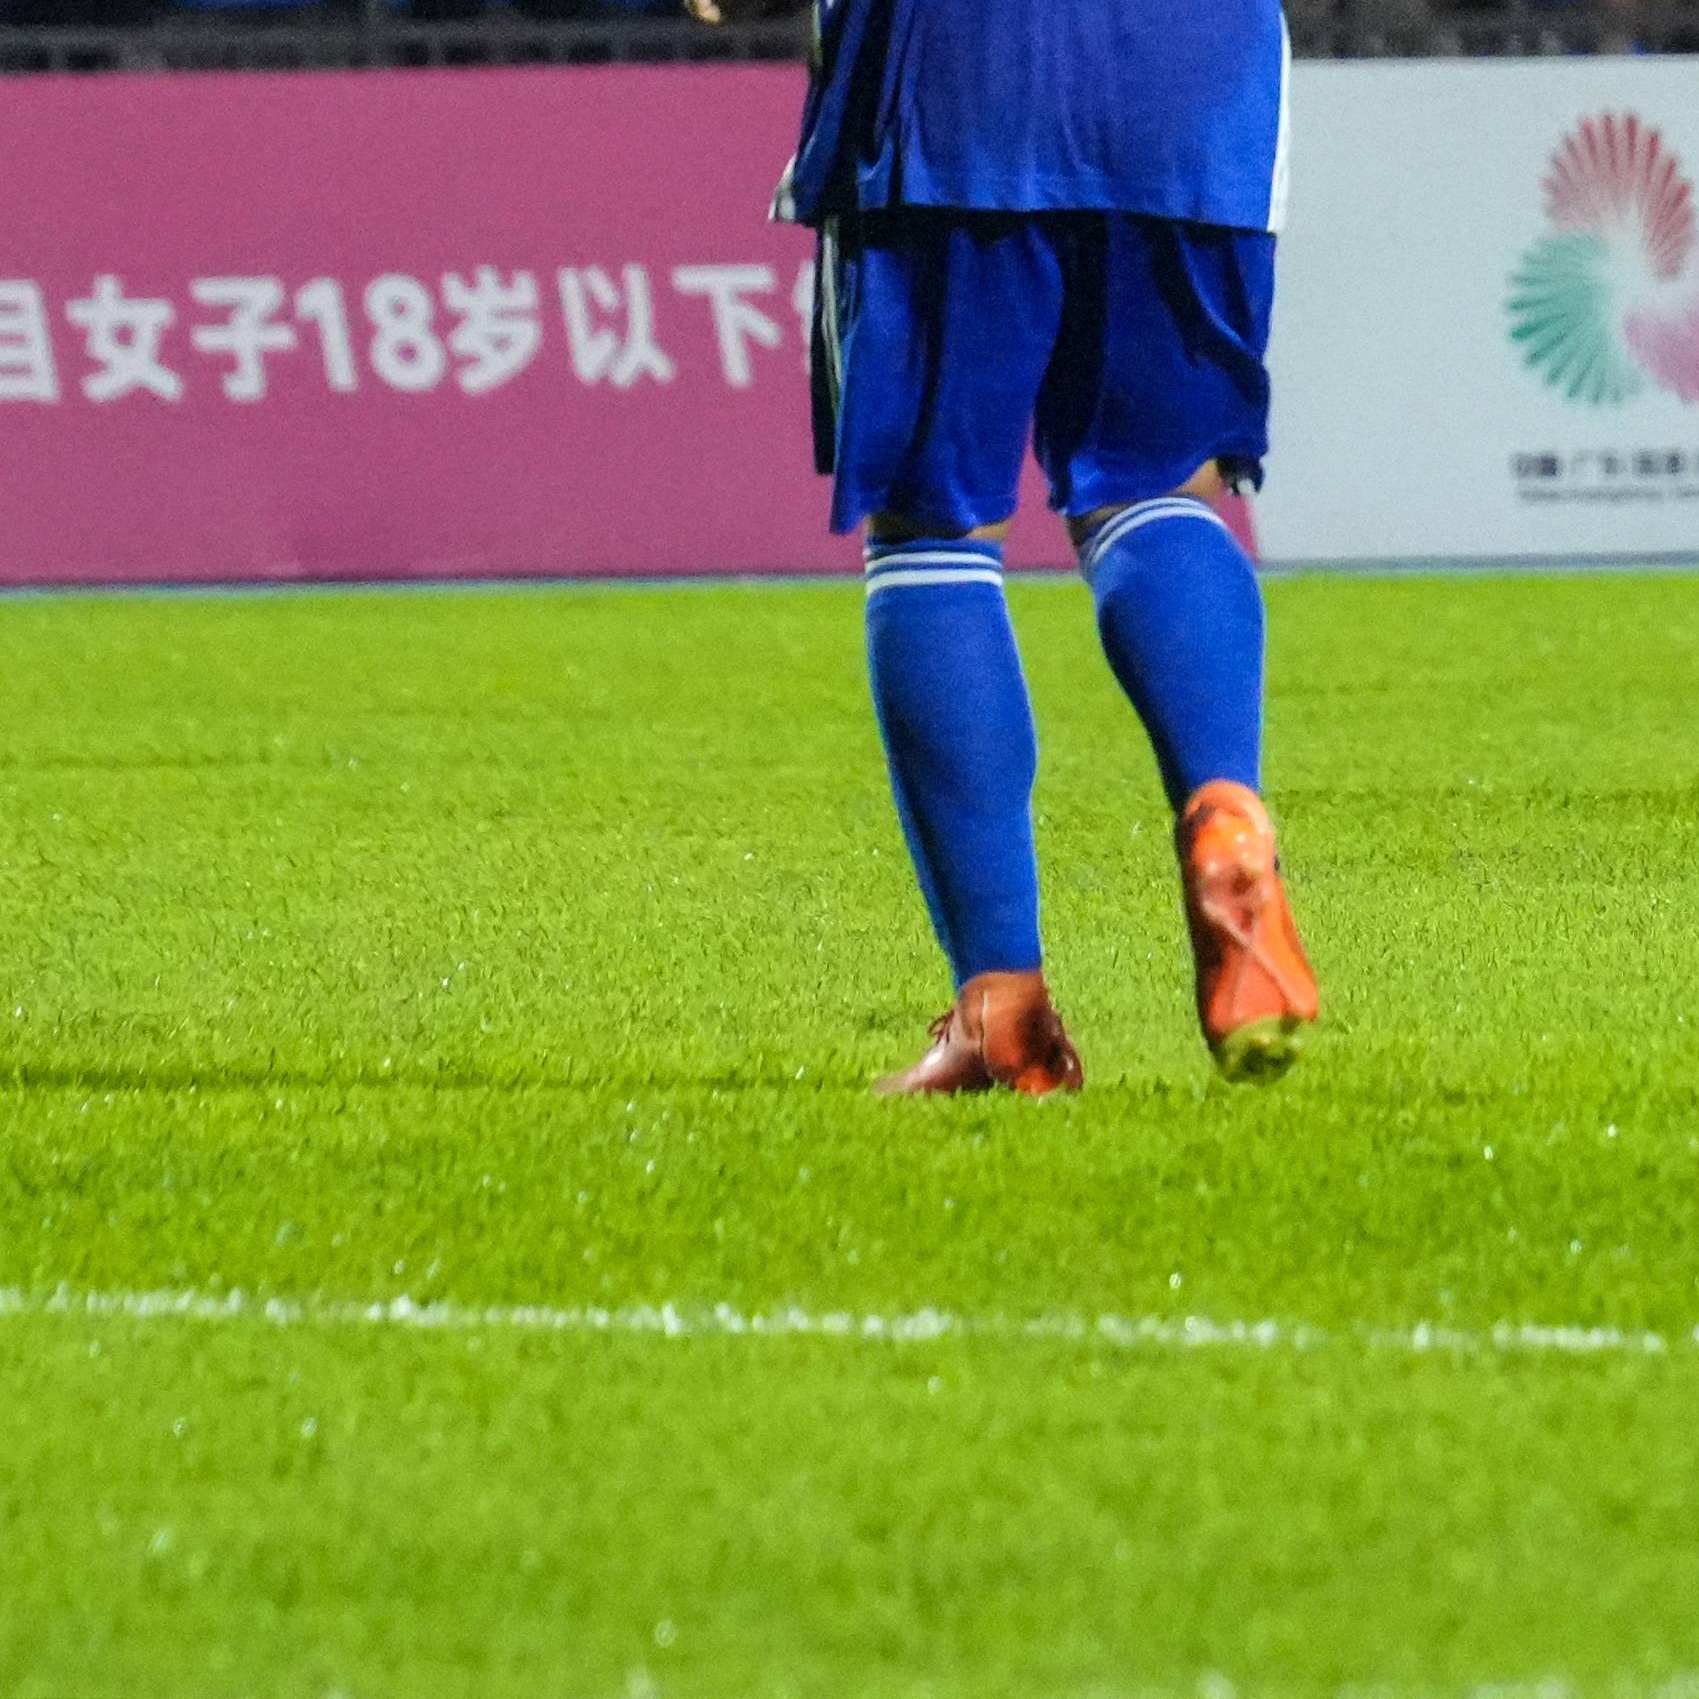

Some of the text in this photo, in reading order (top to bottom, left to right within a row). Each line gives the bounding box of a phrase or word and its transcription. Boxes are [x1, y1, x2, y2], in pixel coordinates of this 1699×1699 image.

[0, 264, 815, 403] 目女子18岁以下
